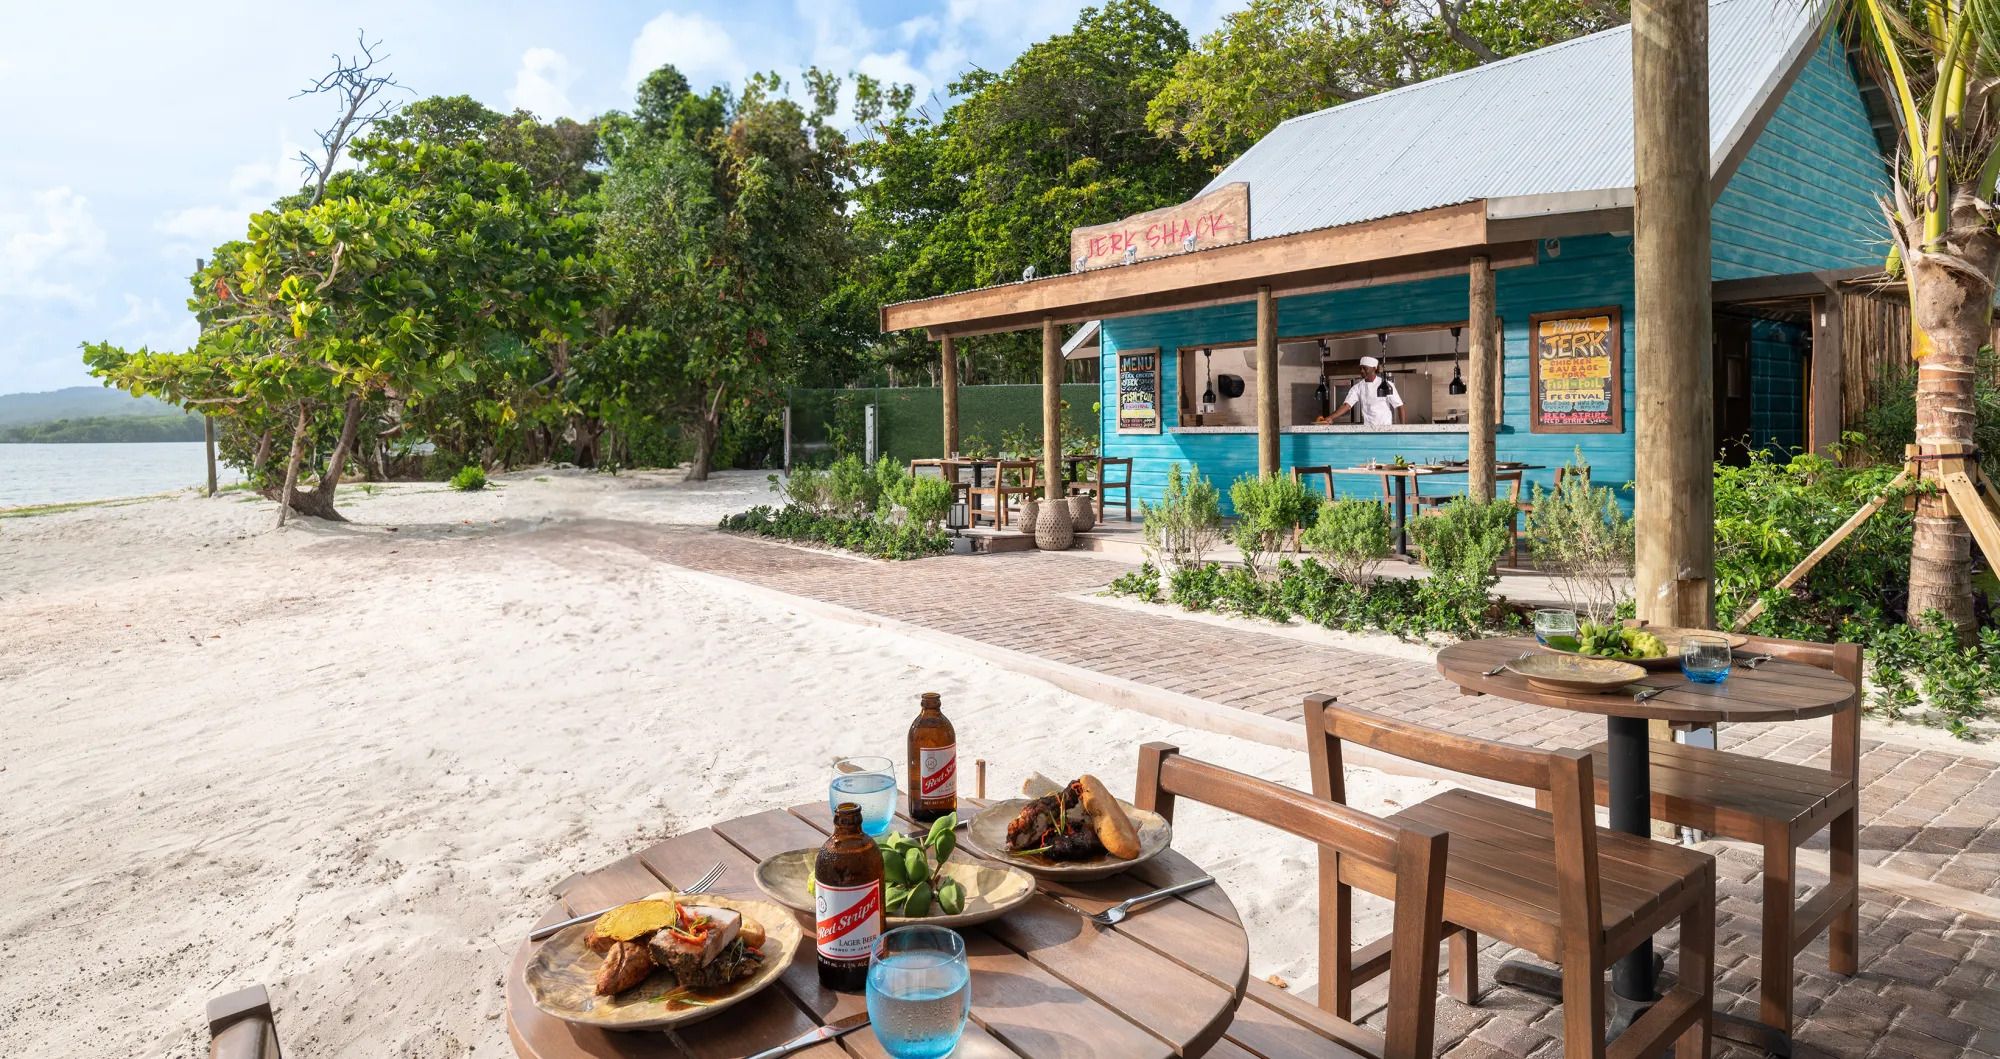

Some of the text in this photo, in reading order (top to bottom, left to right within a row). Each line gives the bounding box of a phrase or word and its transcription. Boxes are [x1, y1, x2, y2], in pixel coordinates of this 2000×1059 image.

[1088, 213, 1234, 258] JERK SHACK
[1543, 332, 1607, 359] JERK
[1123, 356, 1153, 372] MENU
[1549, 365, 1599, 373] SAUSAGE
[1550, 359, 1592, 367] CHICKEN
[1548, 379, 1569, 389] FISH
[1579, 378, 1602, 389] FOIL
[926, 772, 944, 788] Red
[818, 897, 876, 940] Red Stripe
[839, 934, 877, 947] LAGER BEER
